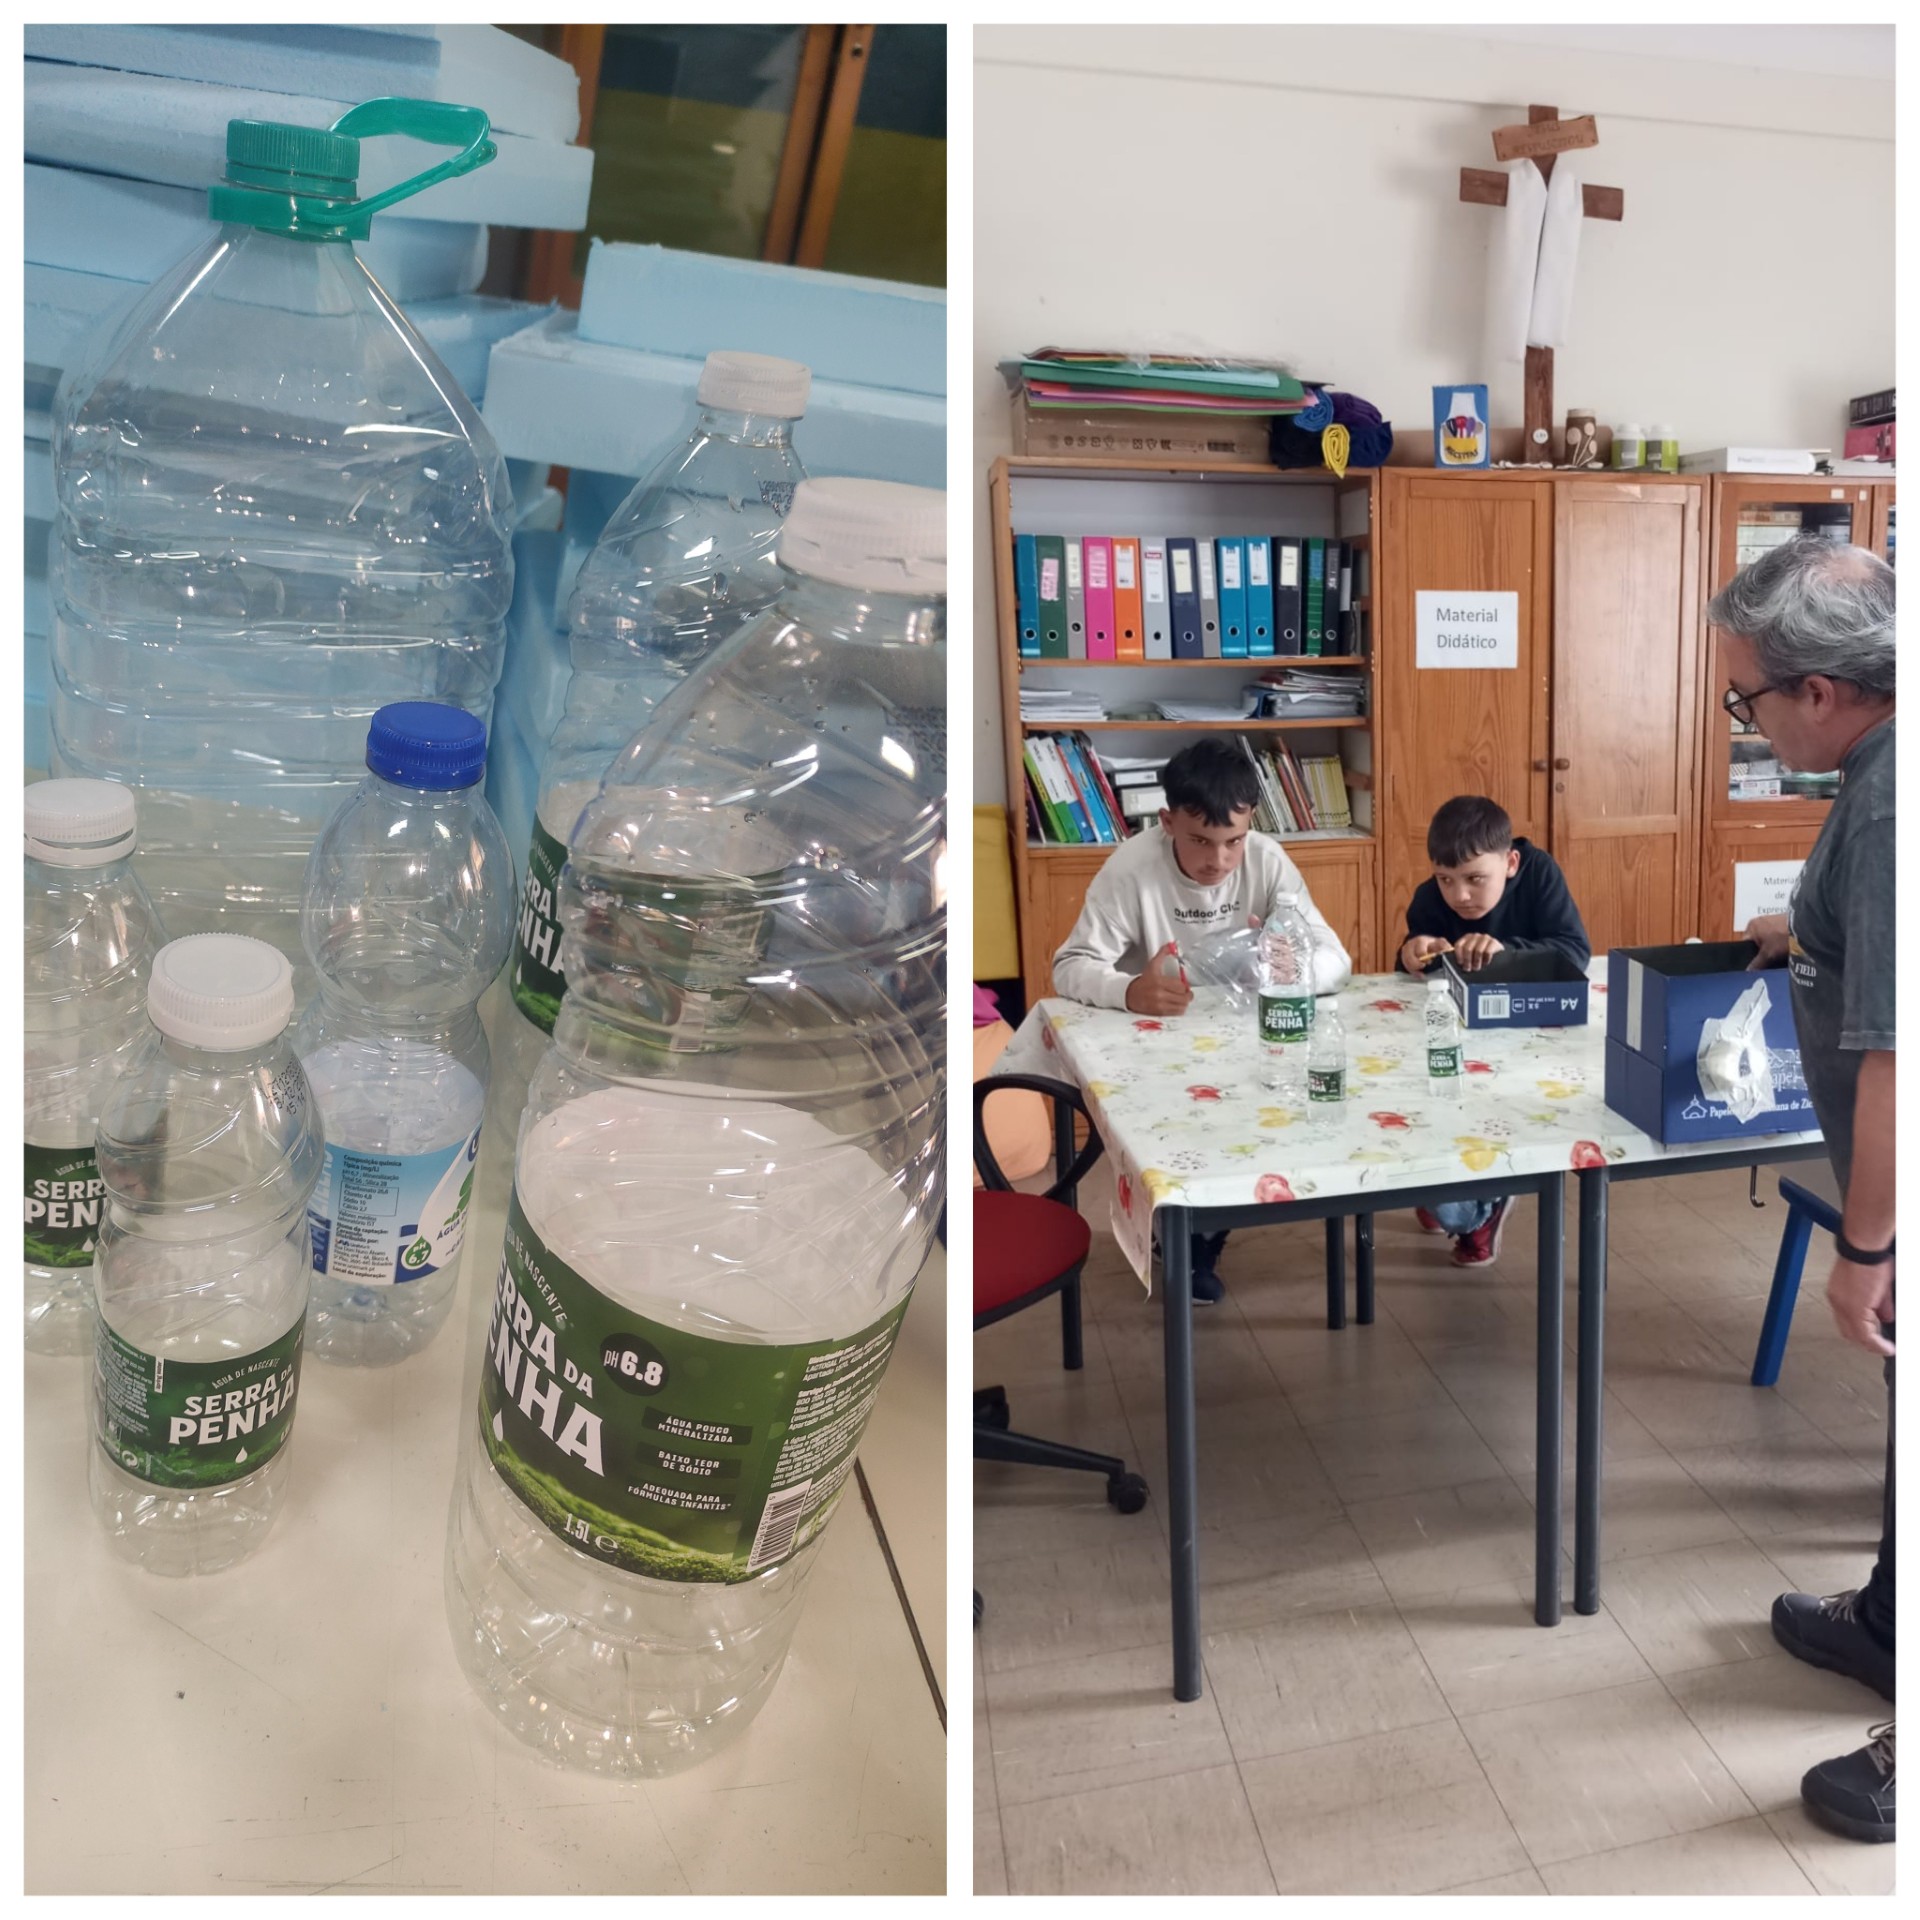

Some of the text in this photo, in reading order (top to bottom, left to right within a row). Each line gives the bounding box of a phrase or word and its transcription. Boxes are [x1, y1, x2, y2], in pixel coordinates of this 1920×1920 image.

[1436, 608, 1498, 622] Material
[1436, 634, 1498, 649] Didático
[1774, 891, 1786, 900] de
[1174, 908, 1217, 918] Outdoor
[1795, 963, 1817, 977] FIELD
[1561, 998, 1579, 1011] A4
[1265, 1016, 1304, 1029] PENHA
[33, 1178, 107, 1200] SERR
[235, 1367, 246, 1380] DE
[562, 1357, 594, 1399] DA
[603, 1349, 663, 1387] pH 6.8
[184, 1372, 277, 1417] SERRA
[281, 1362, 293, 1382] DA
[168, 1371, 294, 1446] PENHA
[658, 1422, 734, 1444] MINERALIZADA
[665, 1415, 730, 1435] ÁGUA POUCO
[658, 1450, 721, 1470] BAIXO TEOR
[662, 1460, 712, 1477] DE SÓDIO
[627, 1485, 678, 1506] FÓRMULAS
[642, 1482, 721, 1504] ADEQUADA PARA
[563, 1513, 590, 1545] 1.5L
